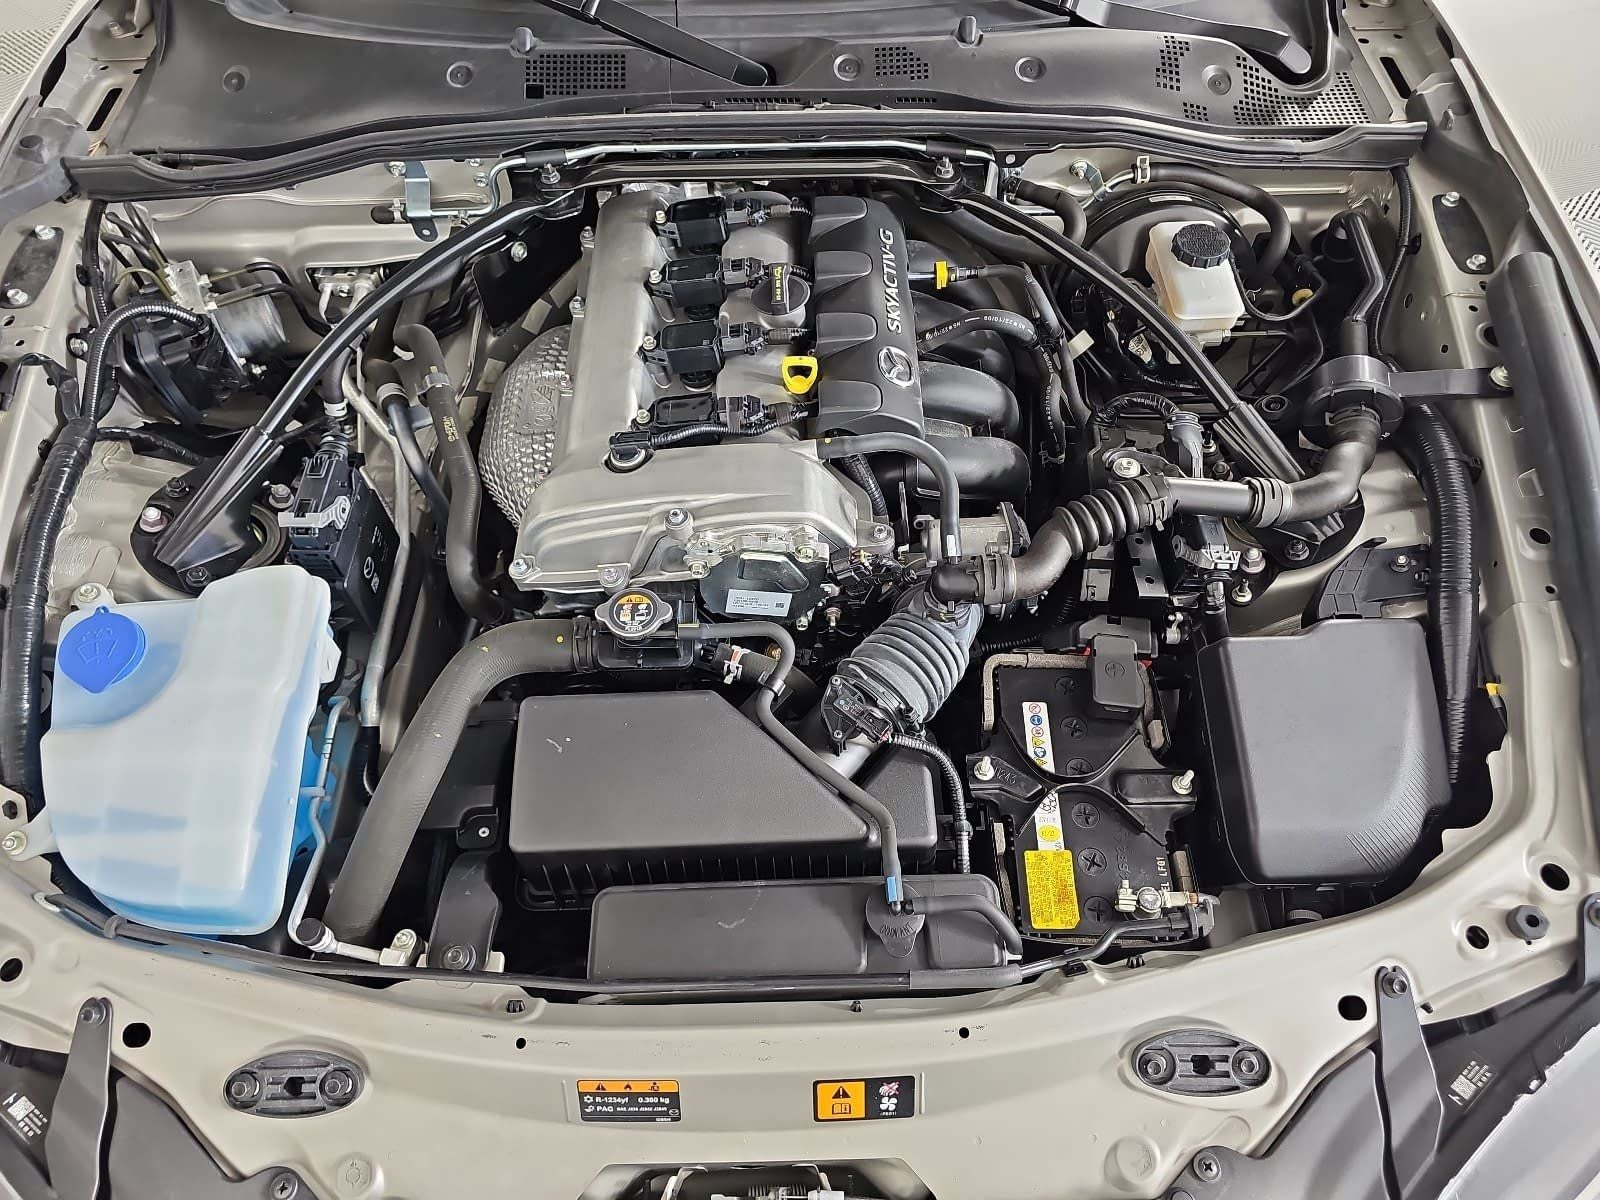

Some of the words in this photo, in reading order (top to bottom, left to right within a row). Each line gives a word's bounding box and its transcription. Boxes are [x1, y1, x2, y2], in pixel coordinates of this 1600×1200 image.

[879, 228, 902, 335] SKYACTIV-G
[595, 1096, 629, 1104] R-1234yf
[659, 1096, 670, 1104] kg
